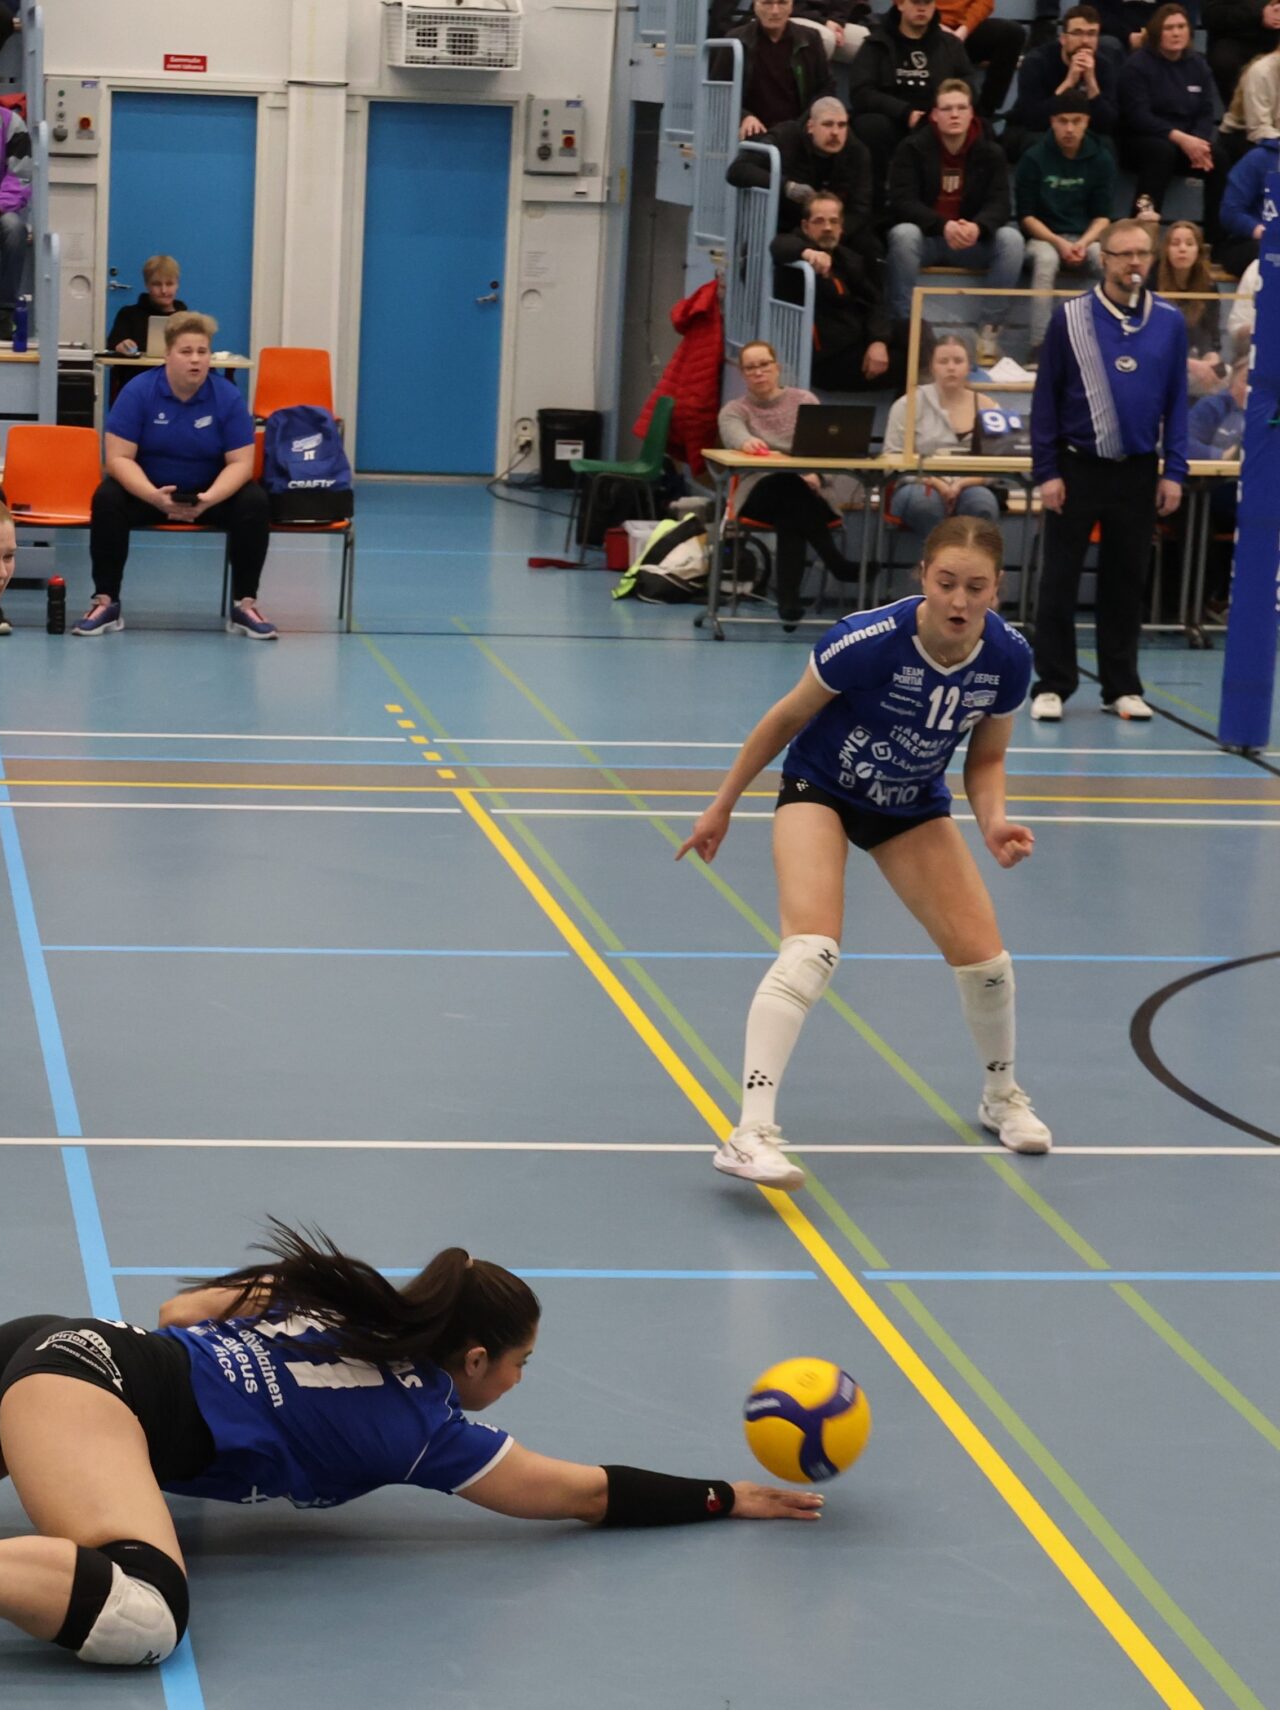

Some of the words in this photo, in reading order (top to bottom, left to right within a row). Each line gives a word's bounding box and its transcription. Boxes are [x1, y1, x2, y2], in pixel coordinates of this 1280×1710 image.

[982, 411, 1007, 432] 9
[288, 479, 328, 489] CRAFT
[820, 616, 897, 665] minimani
[925, 685, 961, 731] 12
